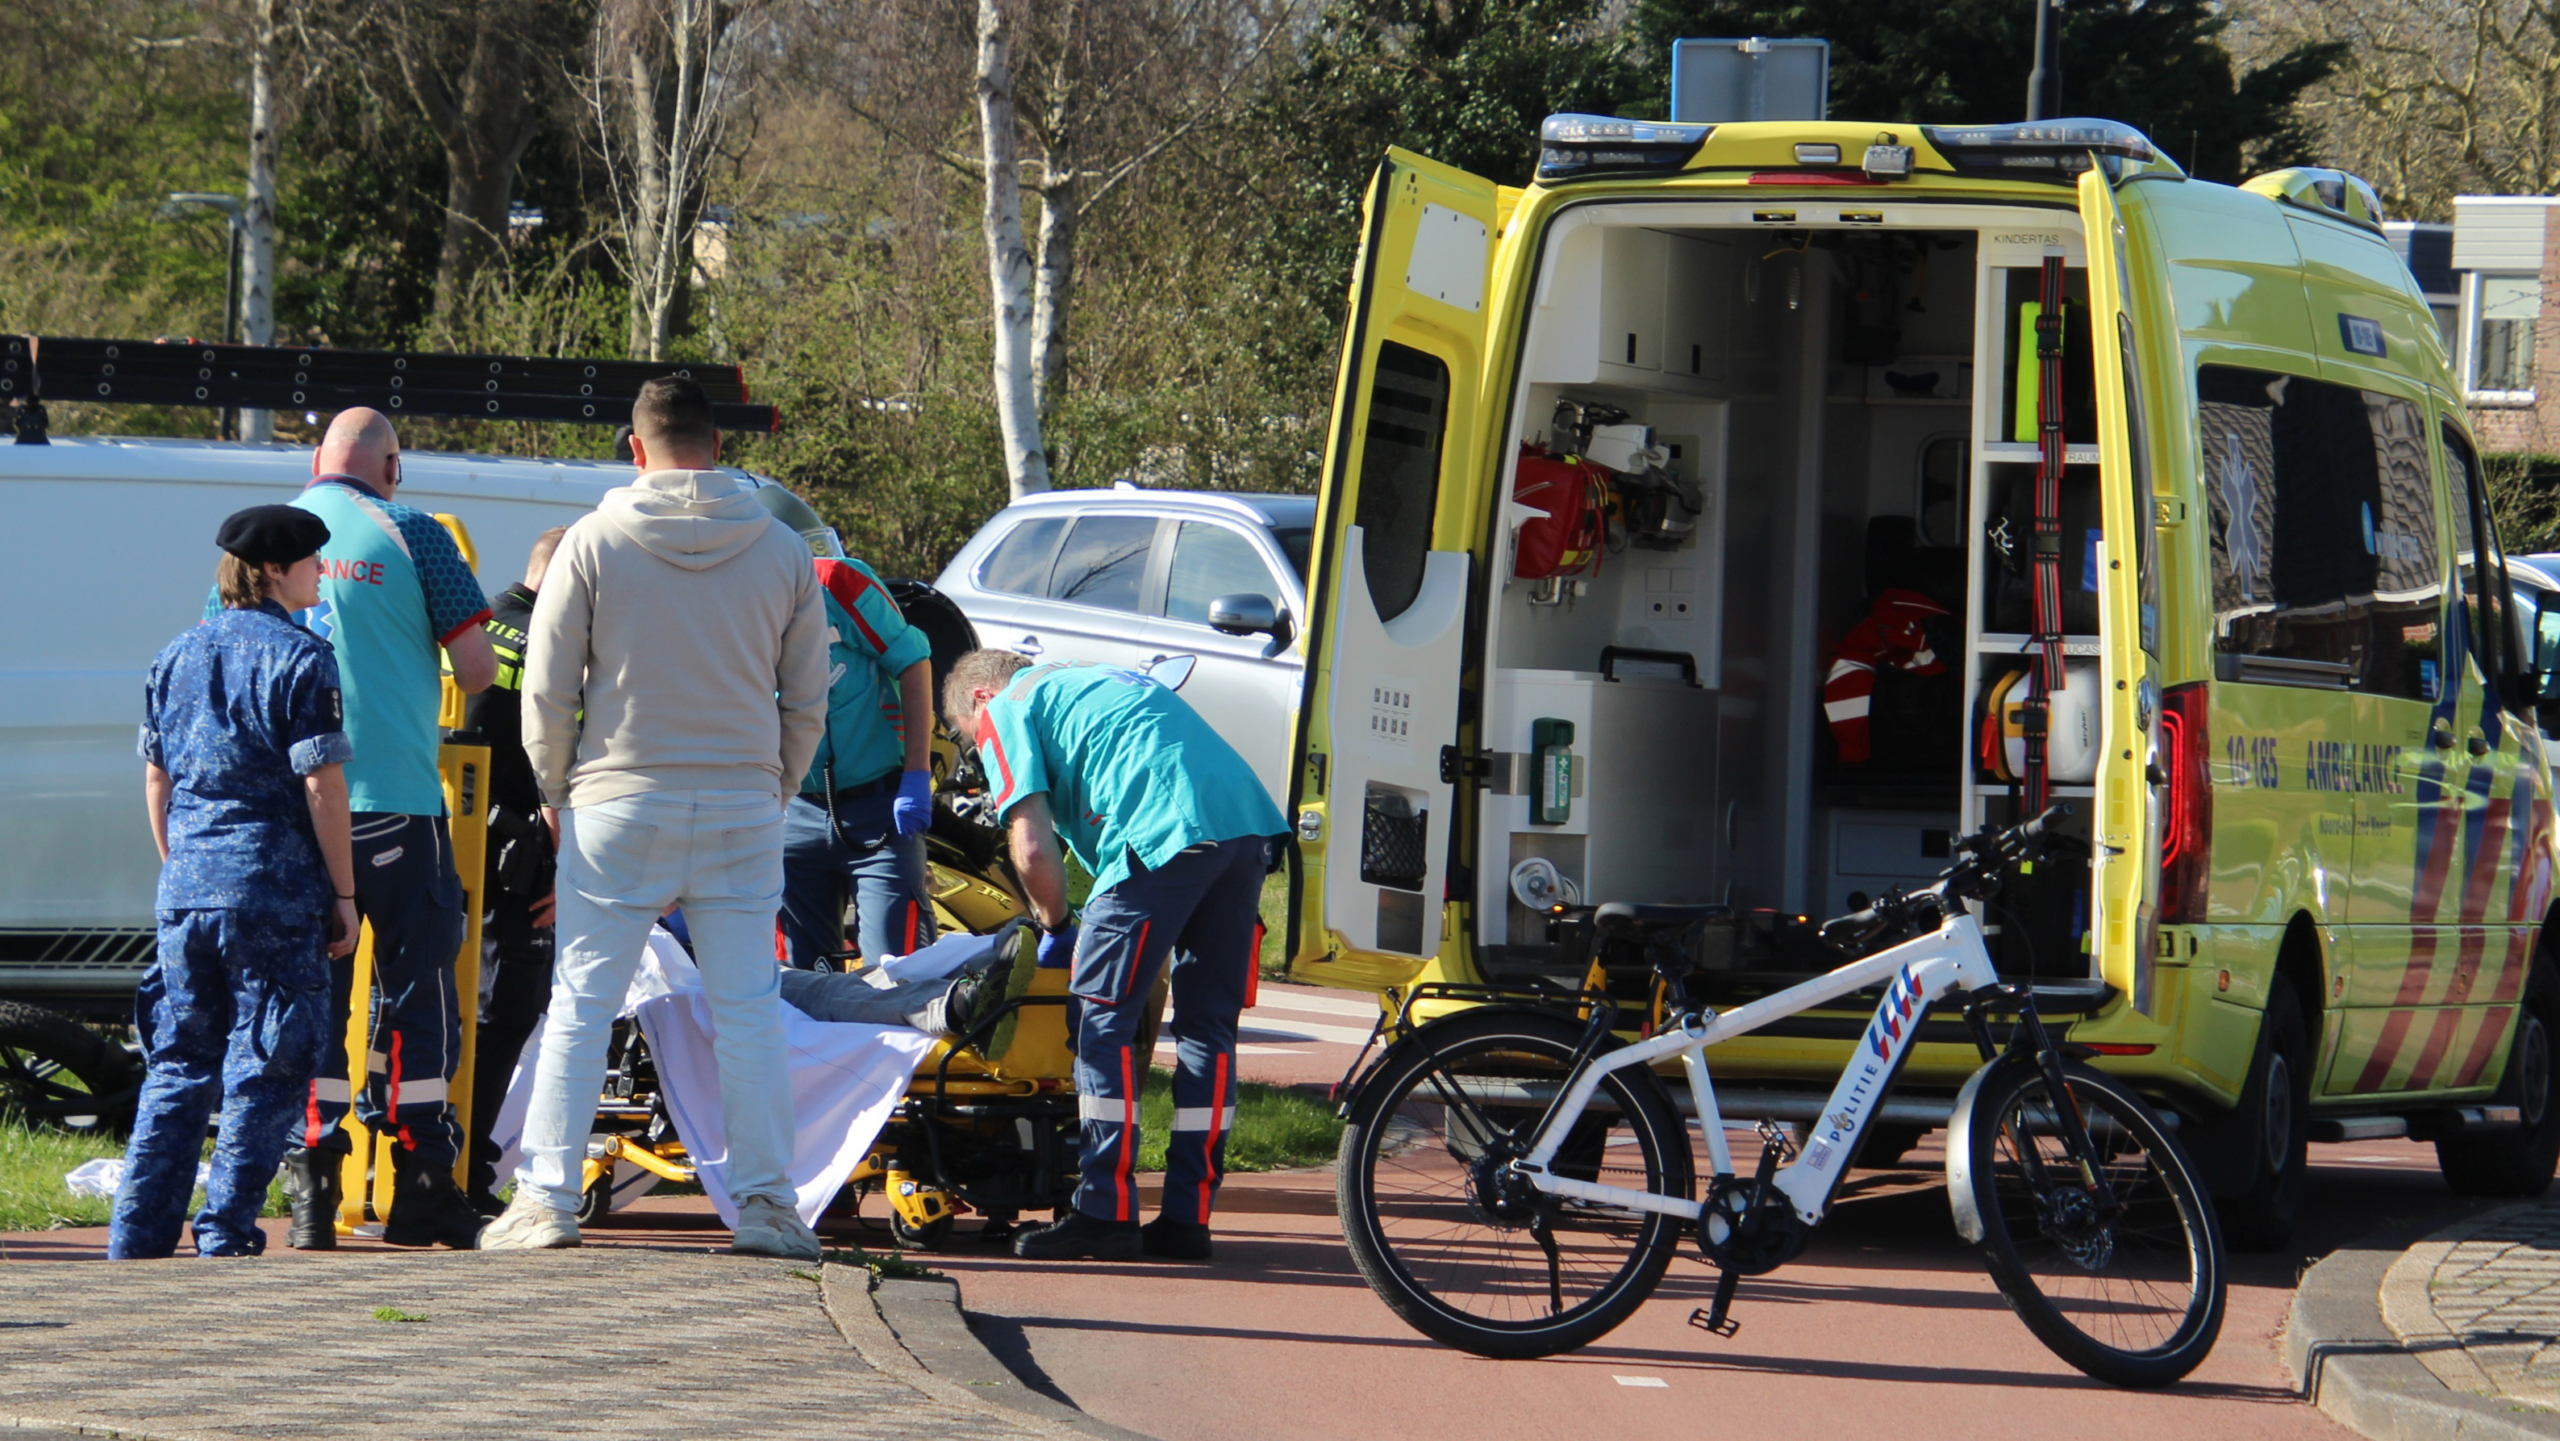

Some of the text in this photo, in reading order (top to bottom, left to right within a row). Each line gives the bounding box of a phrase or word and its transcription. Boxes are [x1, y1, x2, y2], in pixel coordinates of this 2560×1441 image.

[1994, 234, 2059, 245] KINDERTAS
[2064, 452, 2099, 463] RAUM
[319, 558, 385, 586] ANCE
[485, 619, 519, 640] TIE
[2306, 740, 2404, 794] AMBULANCE
[1829, 1064, 1878, 1142] POLITIE
